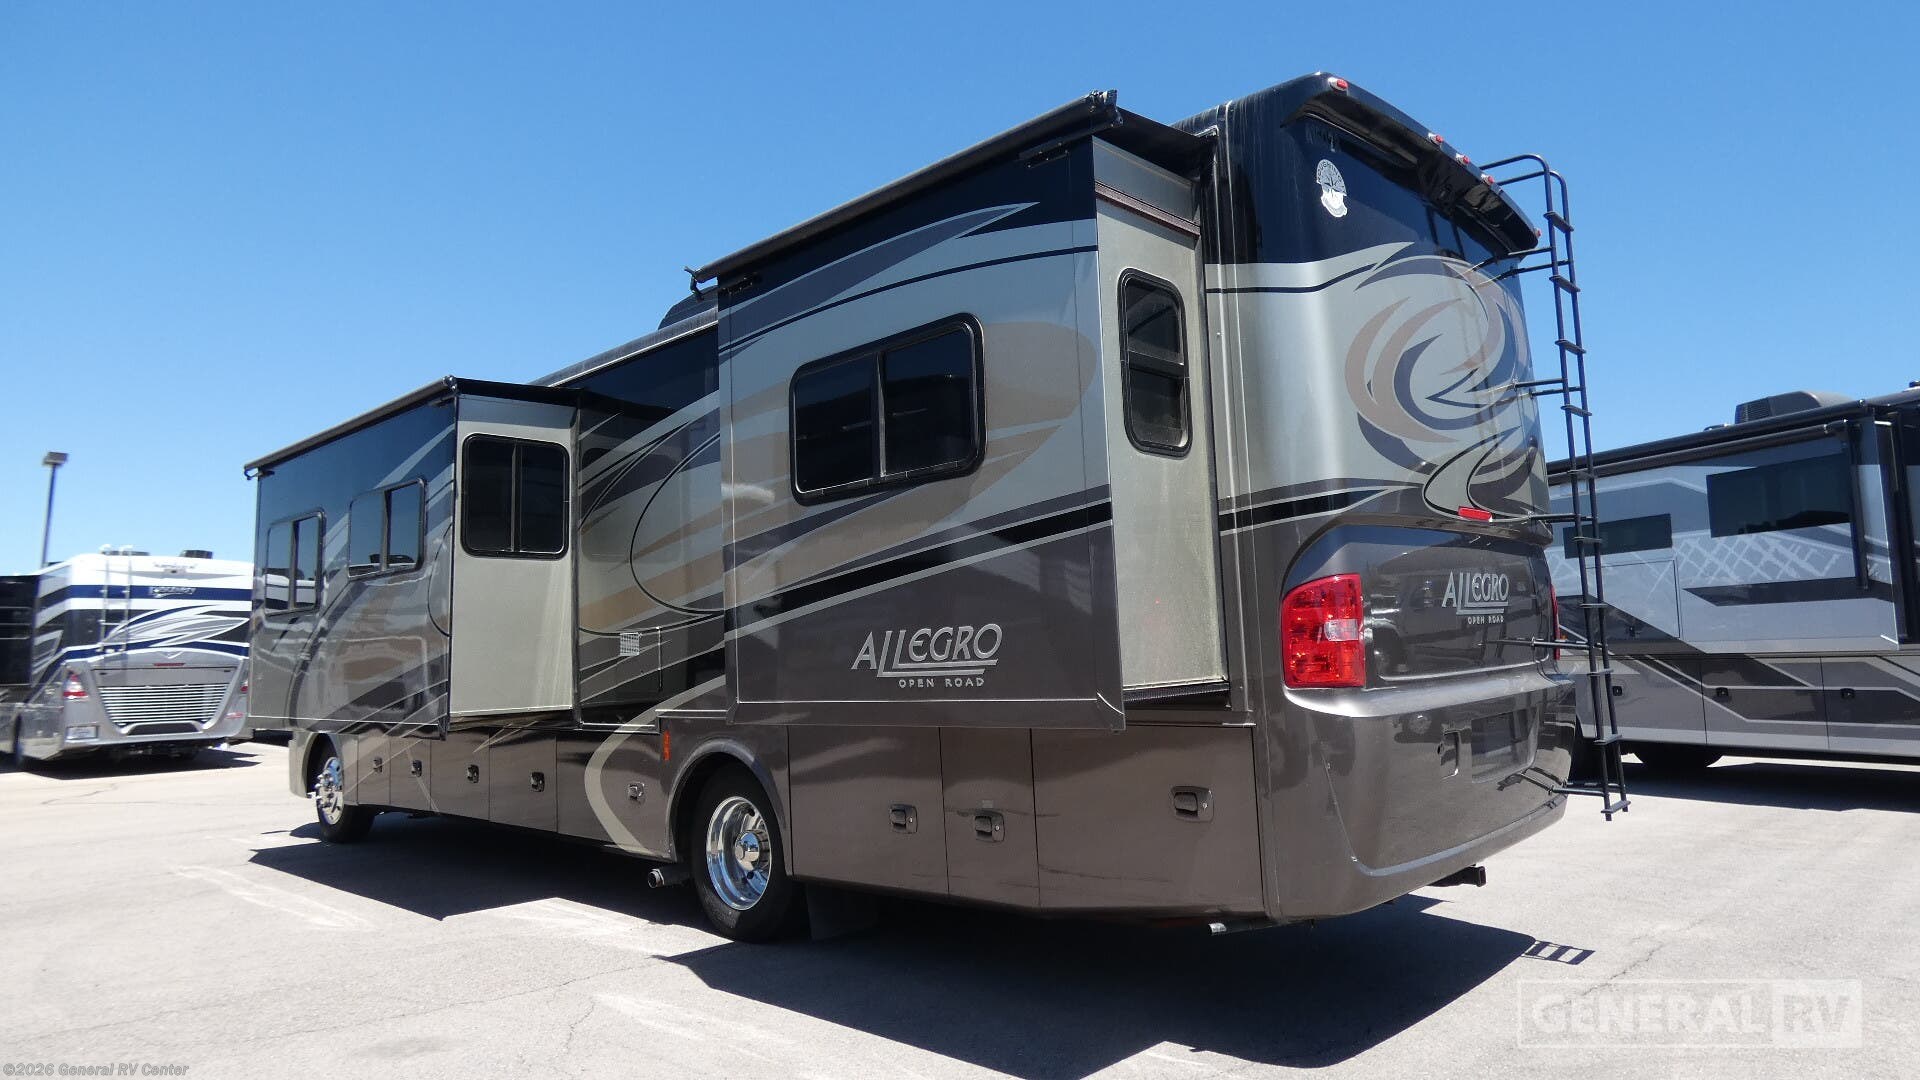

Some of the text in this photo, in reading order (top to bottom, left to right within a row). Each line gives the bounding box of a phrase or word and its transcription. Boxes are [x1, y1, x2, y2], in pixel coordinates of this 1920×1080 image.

[1441, 571, 1509, 615] ALLEGRO
[1467, 615, 1504, 625] OPEN ROAD
[851, 623, 1003, 677] ALLEGRO
[898, 677, 985, 689] OPEN ROAD
